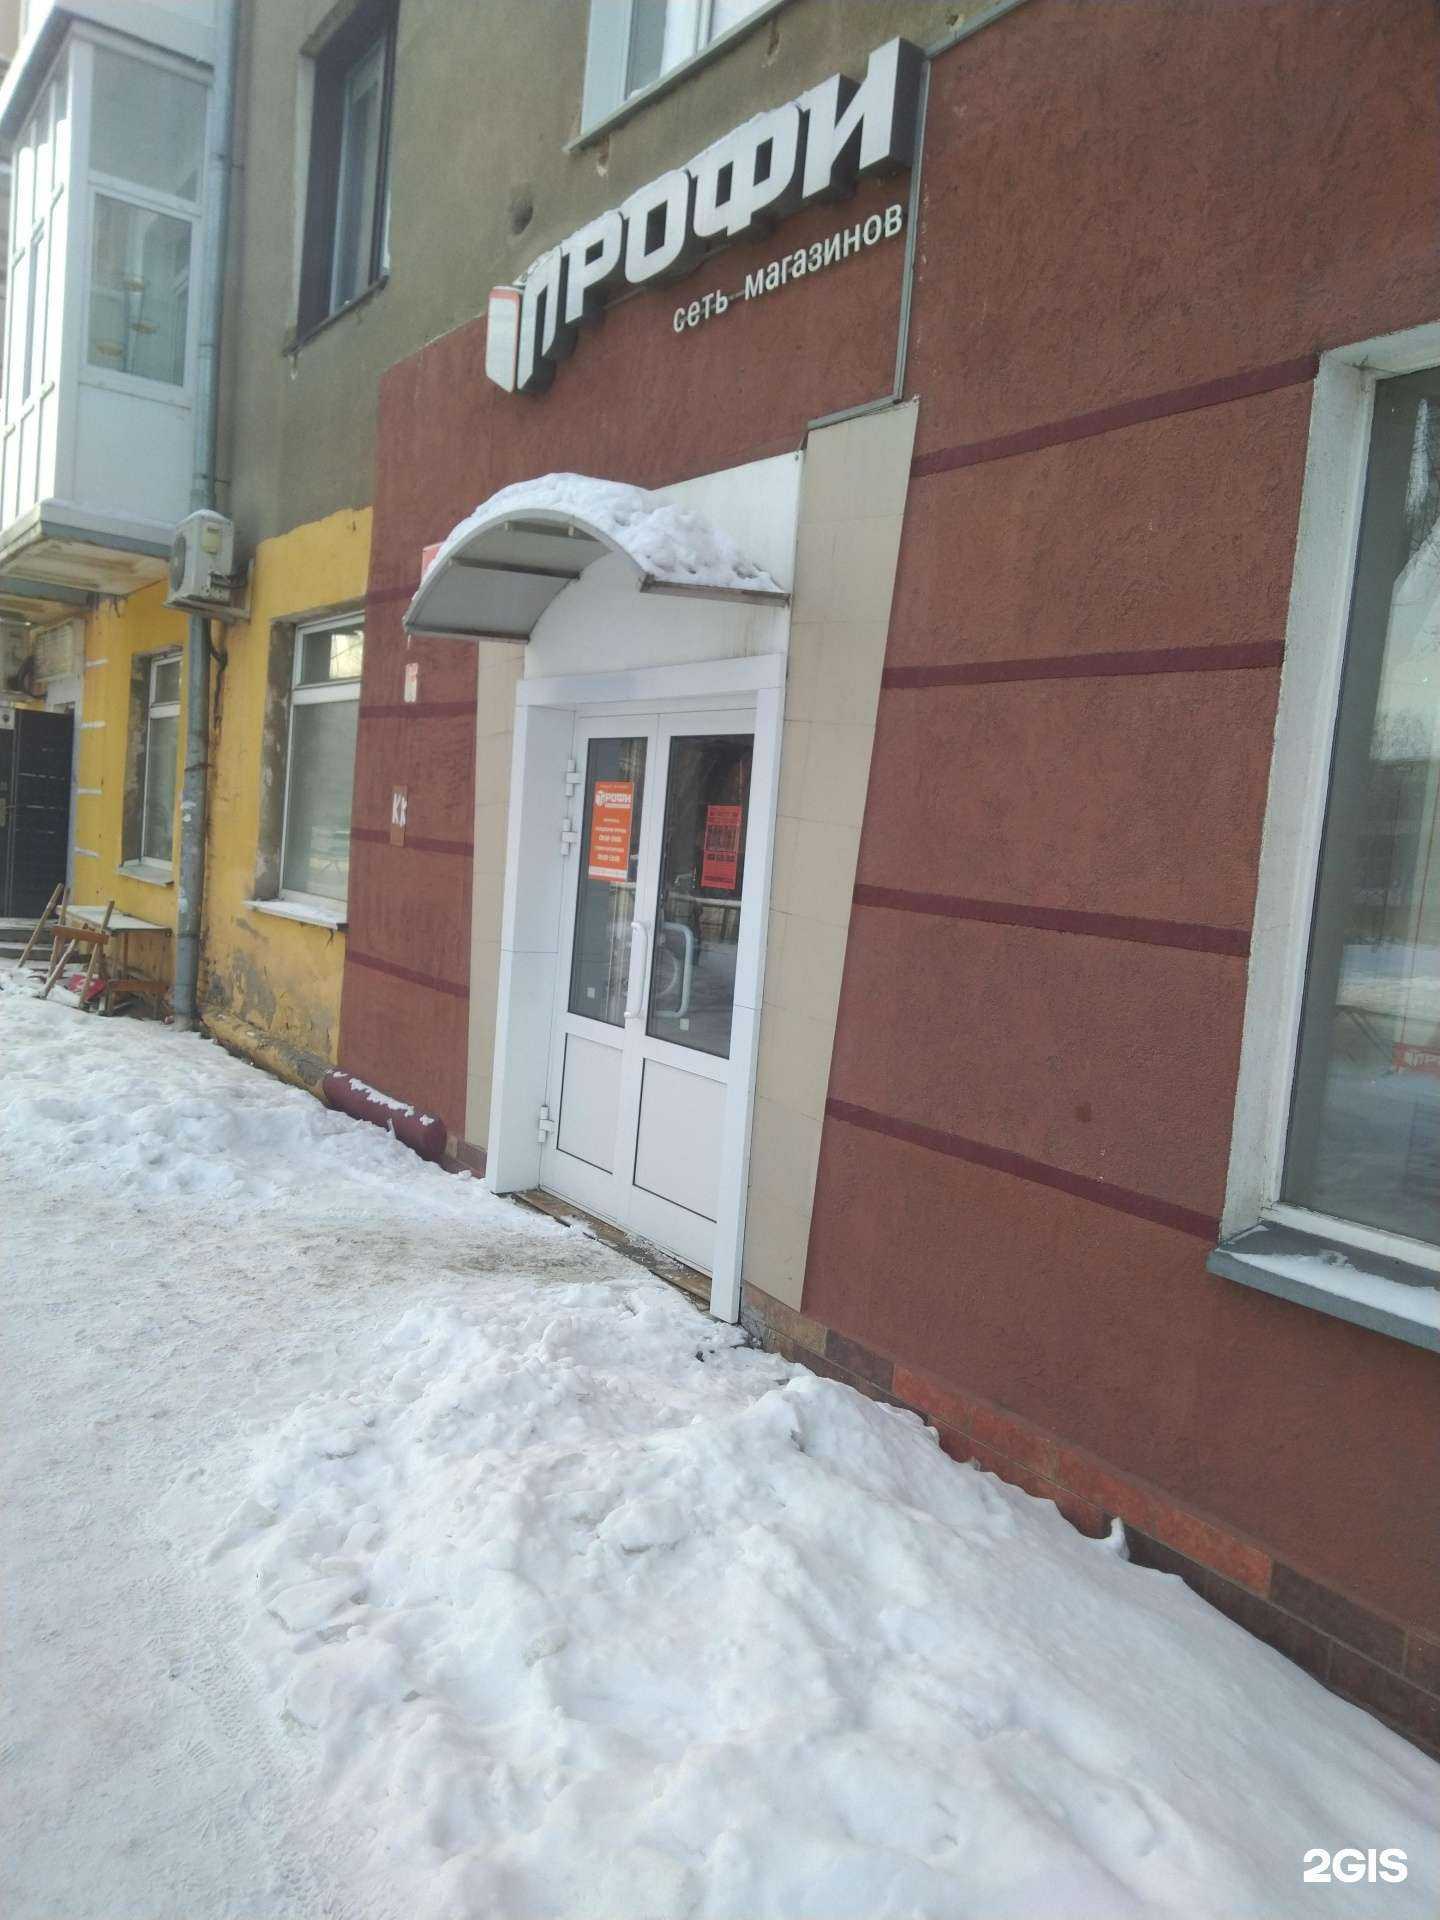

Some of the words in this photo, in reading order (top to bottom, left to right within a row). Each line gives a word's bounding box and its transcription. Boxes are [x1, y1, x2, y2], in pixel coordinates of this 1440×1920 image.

[516, 37, 902, 390] ПРОФИ
[673, 289, 728, 333] сеть
[744, 204, 903, 301] магазинов
